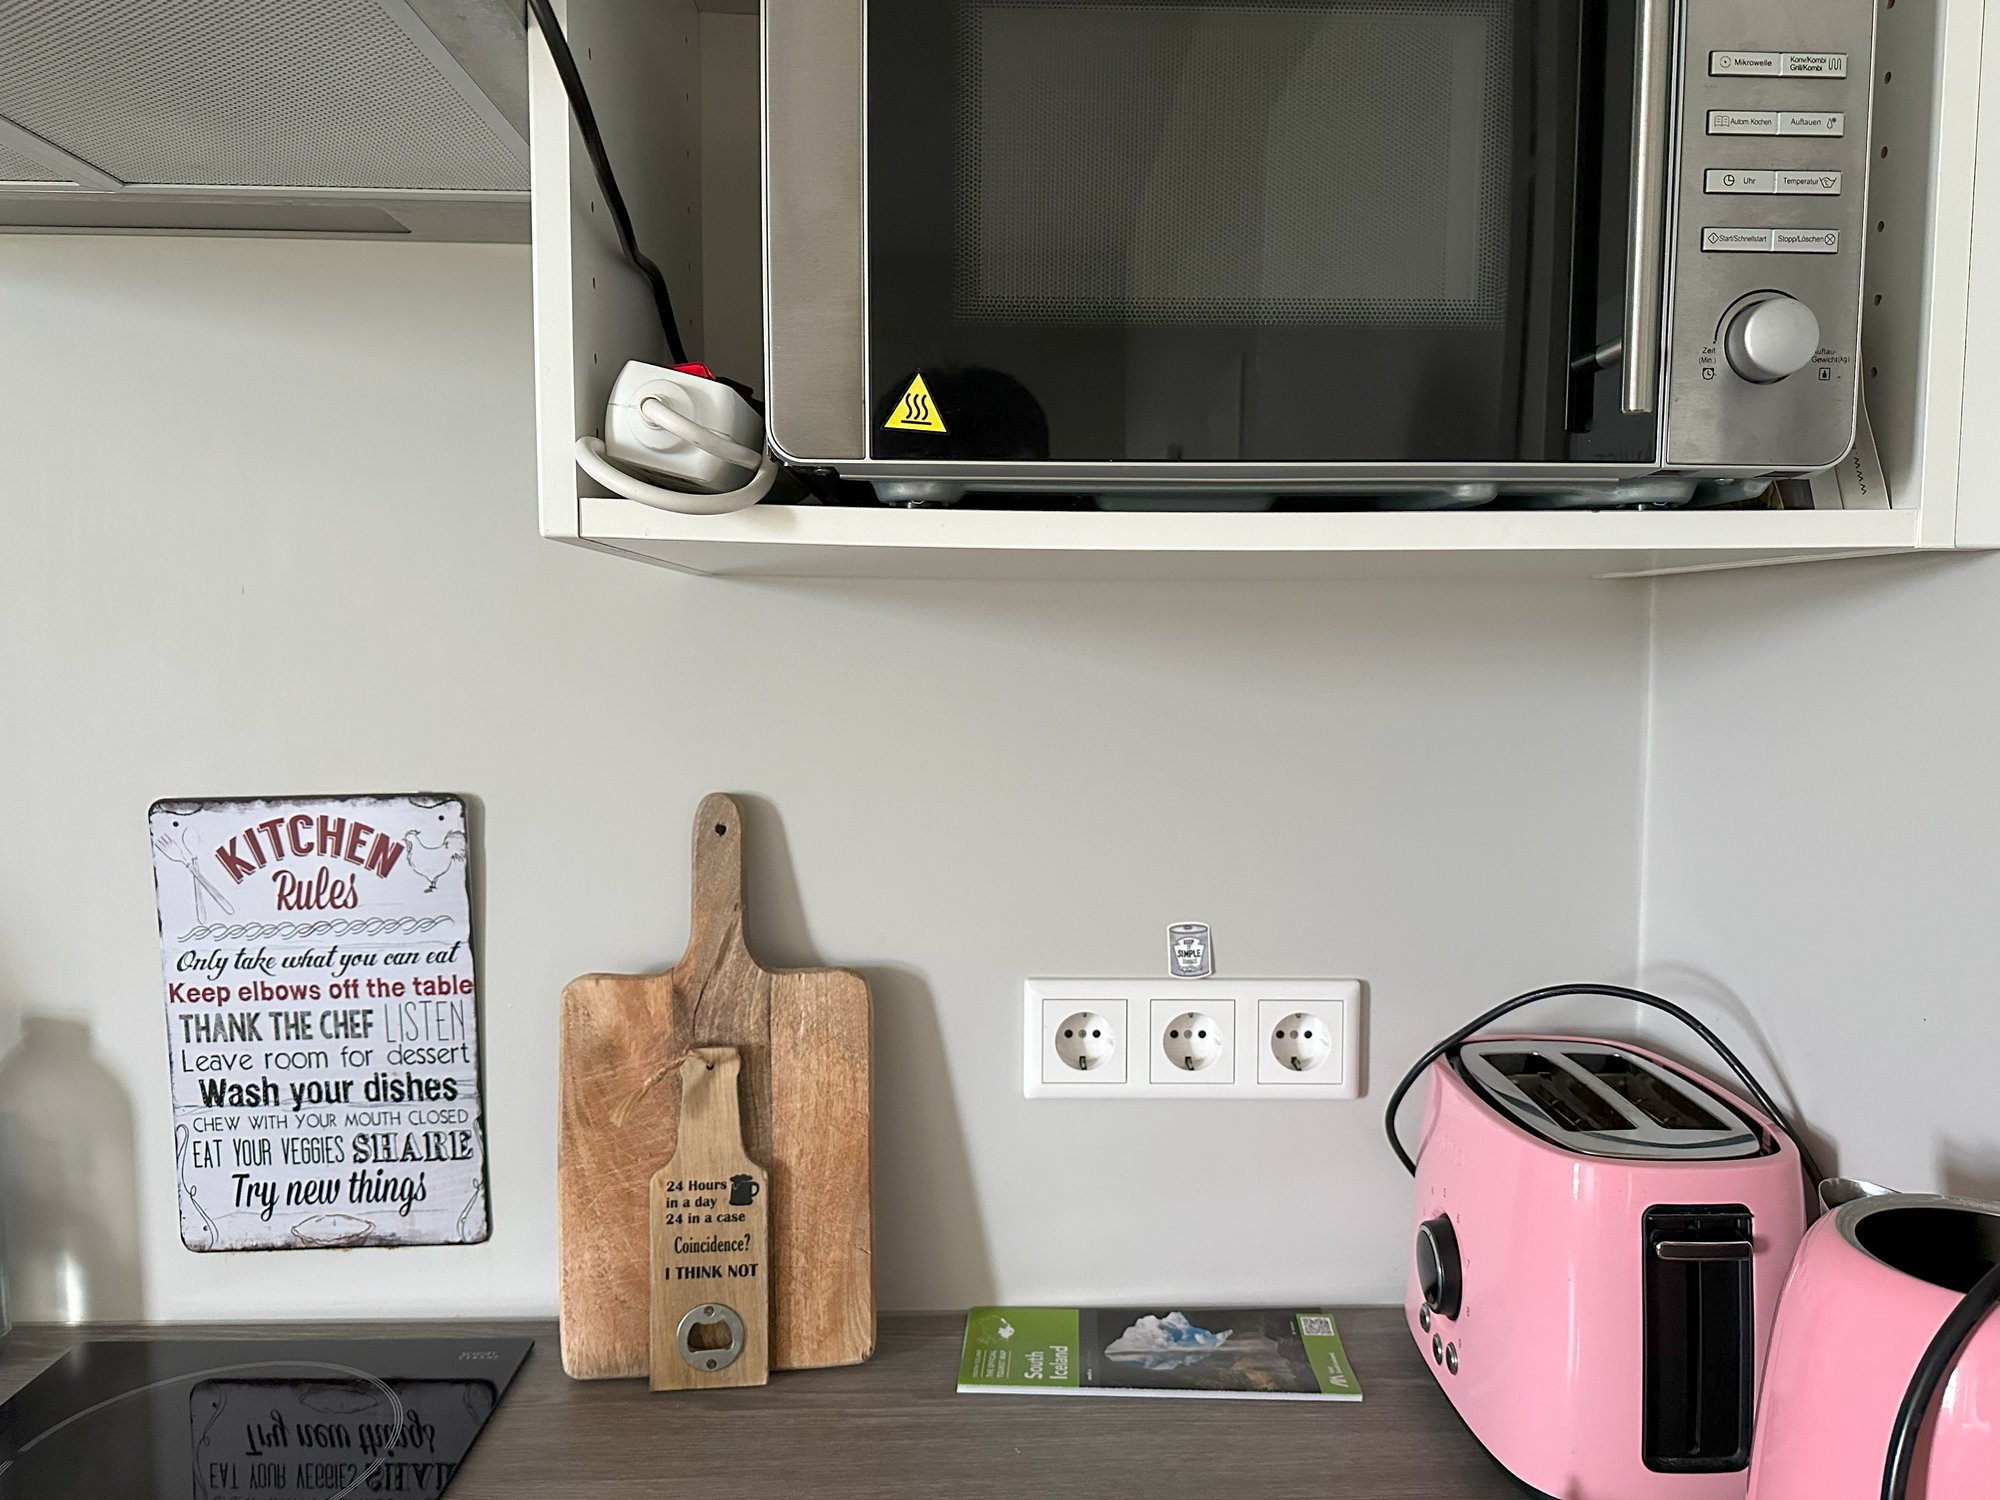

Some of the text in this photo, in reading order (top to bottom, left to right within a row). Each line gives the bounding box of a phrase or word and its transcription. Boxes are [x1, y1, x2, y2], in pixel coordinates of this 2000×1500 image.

[1734, 58, 1773, 67] Mikrowelle
[1750, 118, 1772, 126] Kochen
[1790, 118, 1822, 126] Auftauen
[1743, 177, 1756, 185] Uhr
[1783, 177, 1819, 187] Temperatur
[1777, 234, 1824, 244] Stopp/Löschen
[215, 814, 405, 884] KITCHEN
[272, 866, 359, 911] Rules
[176, 941, 461, 980] Only take what you can eat
[1177, 949, 1201, 958] SIMPLE
[169, 974, 475, 1006] Keep elbows off the table
[179, 1000, 466, 1043] THANK THE CHEF LISTEN
[181, 1042, 470, 1072] Leave room for dessert
[198, 1071, 458, 1112] Wash your dishes
[193, 1108, 469, 1133] CHEW WITH YOUR MOUTH CLOSED
[193, 1129, 475, 1168] EAT YOUR VEGGIES SHARE
[232, 1168, 427, 1222] Try new things
[666, 1180, 727, 1192] 24 Hours
[666, 1196, 718, 1209] in a day
[666, 1213, 746, 1225] 24 in a case
[674, 1233, 751, 1254] Coincidence?
[665, 1263, 759, 1280] I THINK NOT
[1024, 1351, 1044, 1379] South
[1049, 1345, 1069, 1380] Iceland
